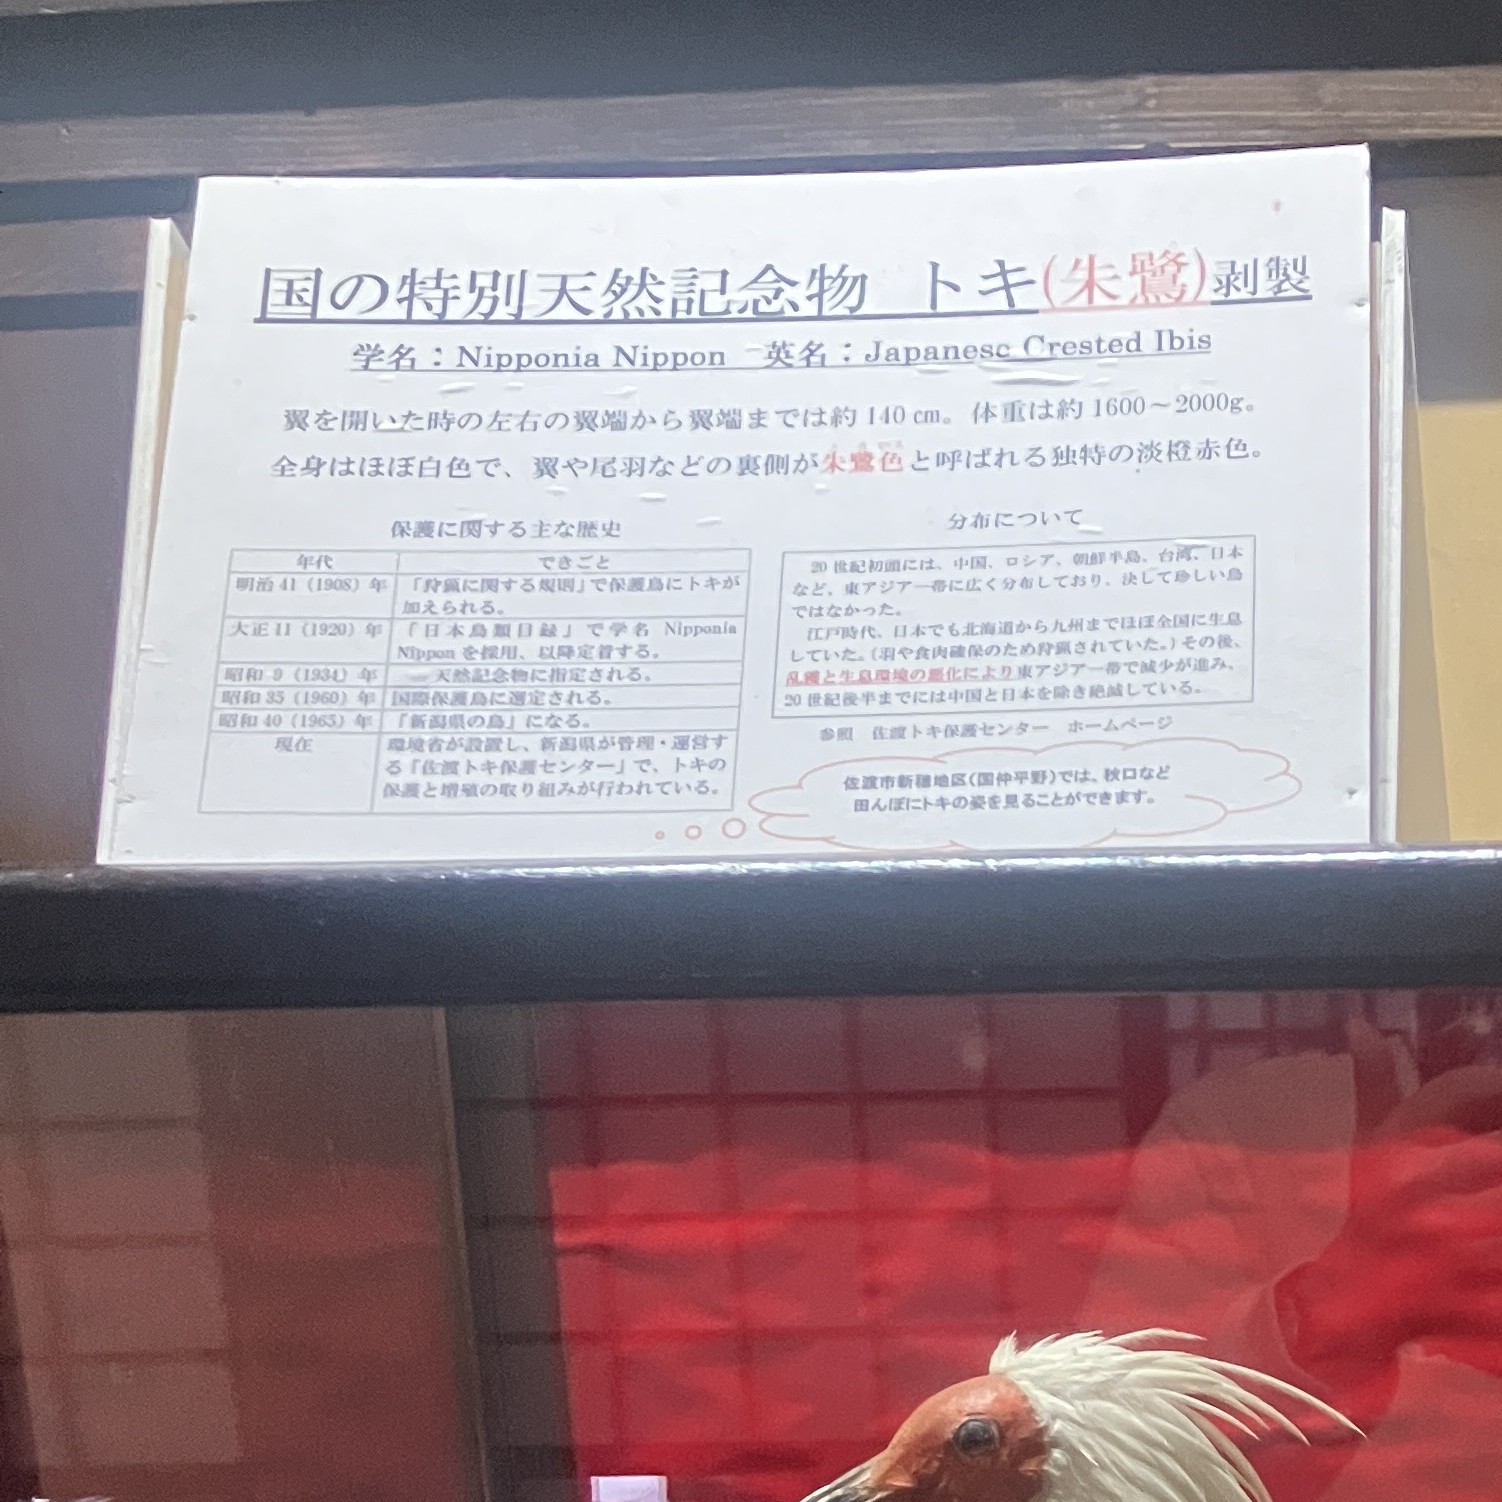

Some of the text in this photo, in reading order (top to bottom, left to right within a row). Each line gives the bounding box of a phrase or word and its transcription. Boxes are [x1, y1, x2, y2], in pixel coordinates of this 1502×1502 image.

[261, 262, 868, 320] 国の特別天然記念物
[611, 343, 727, 370] Nippon
[1022, 331, 1142, 359] Crested
[1155, 327, 1212, 352] Ibis
[947, 508, 1084, 531] 分布について
[1068, 715, 1175, 733] ホームページ
